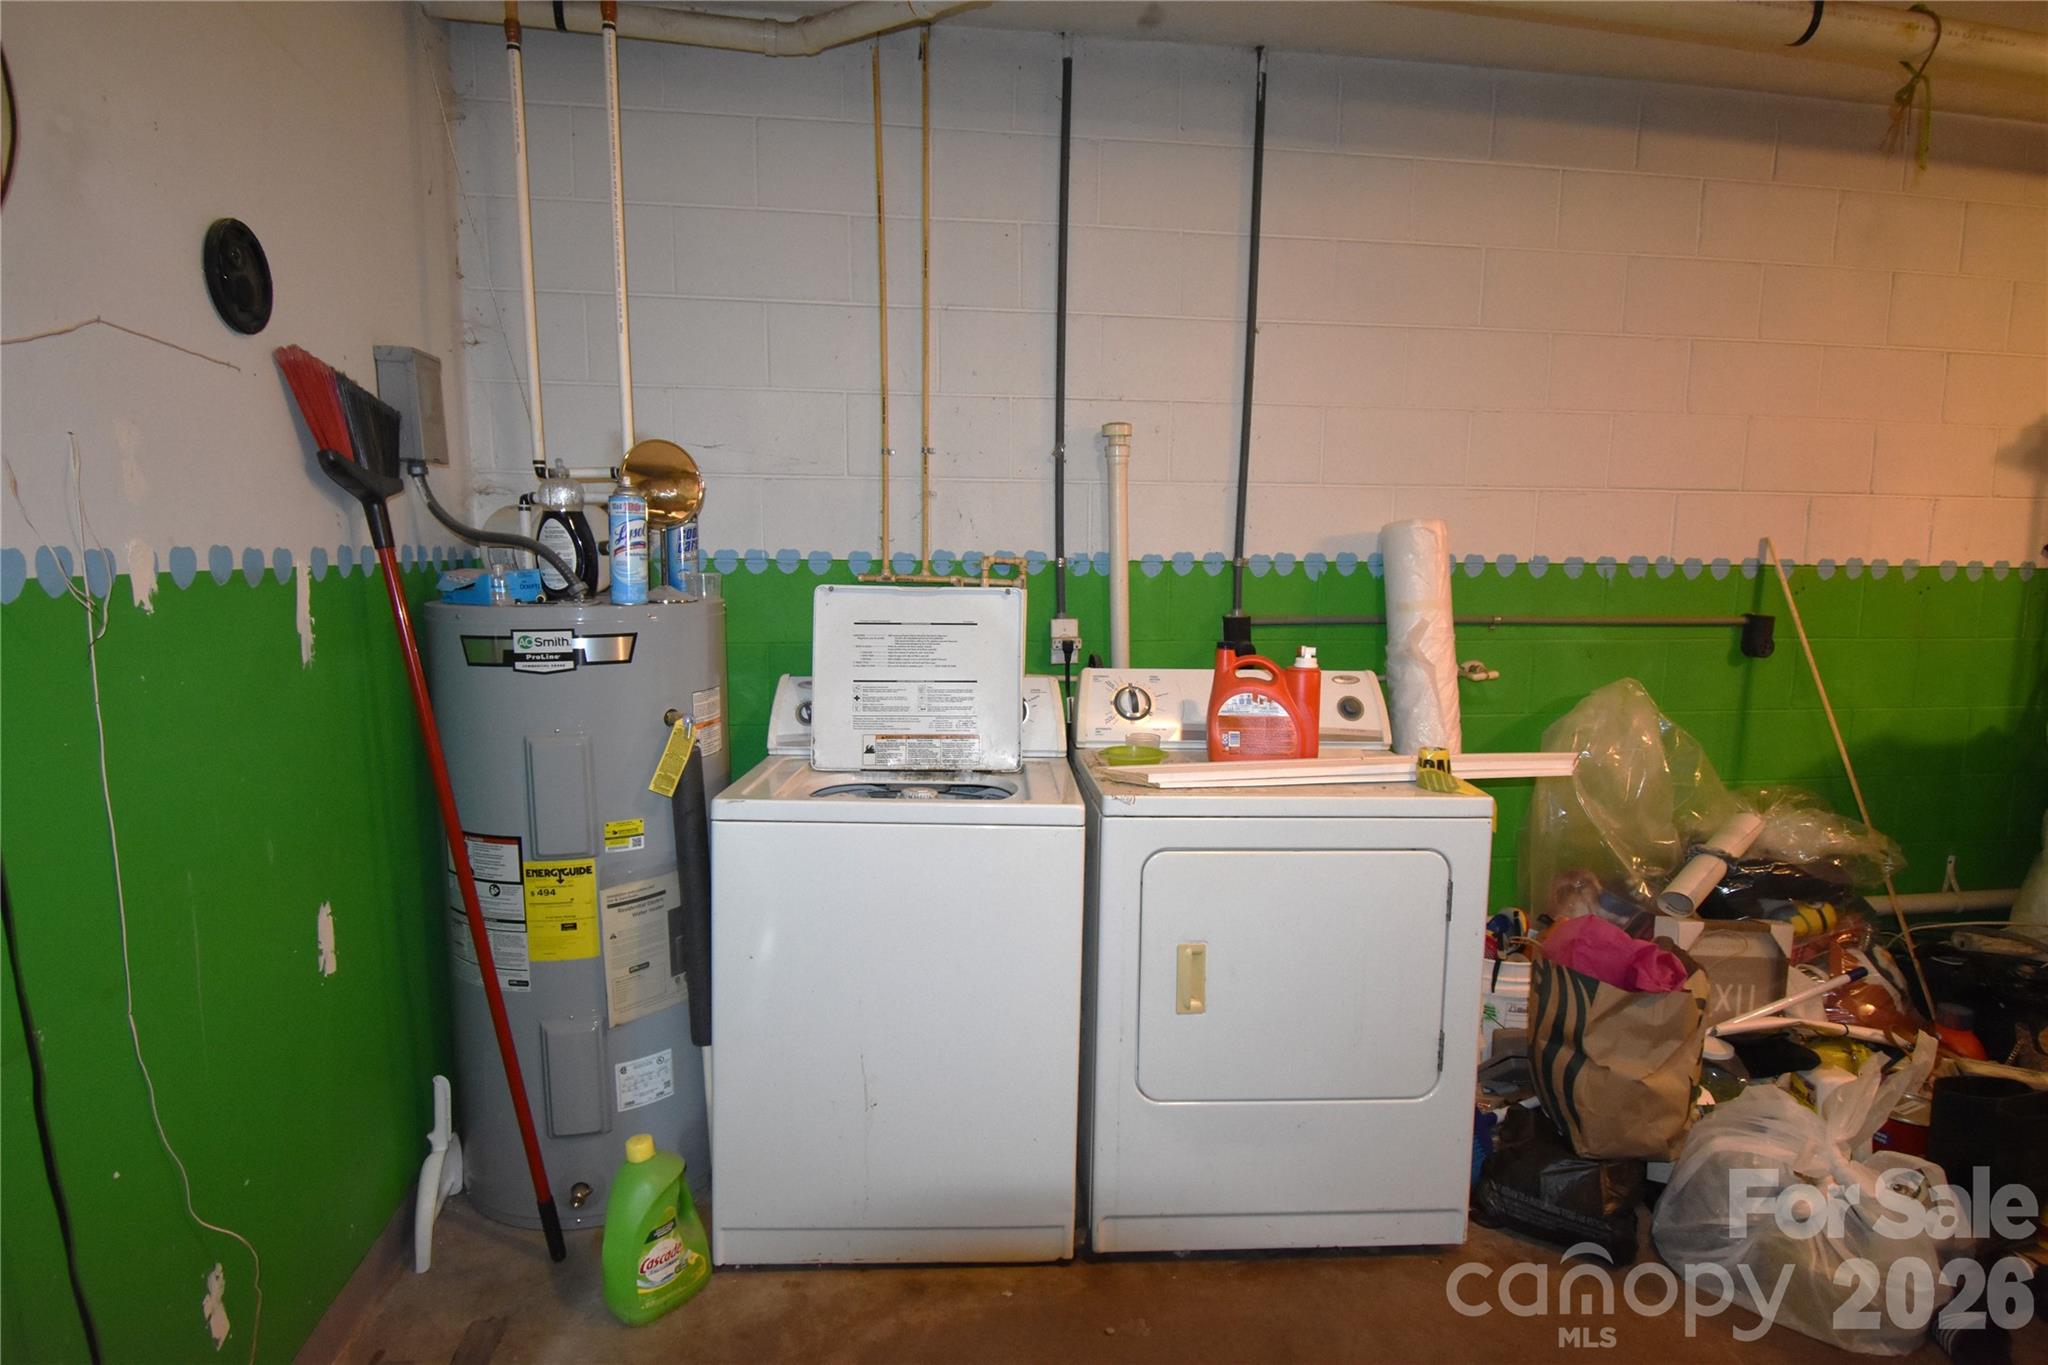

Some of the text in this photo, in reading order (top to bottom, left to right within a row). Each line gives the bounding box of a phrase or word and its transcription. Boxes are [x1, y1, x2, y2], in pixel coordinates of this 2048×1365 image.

[615, 522, 646, 546] Lysol
[525, 866, 592, 880] ENERGYGUIDE
[640, 1243, 682, 1274] Cascade
